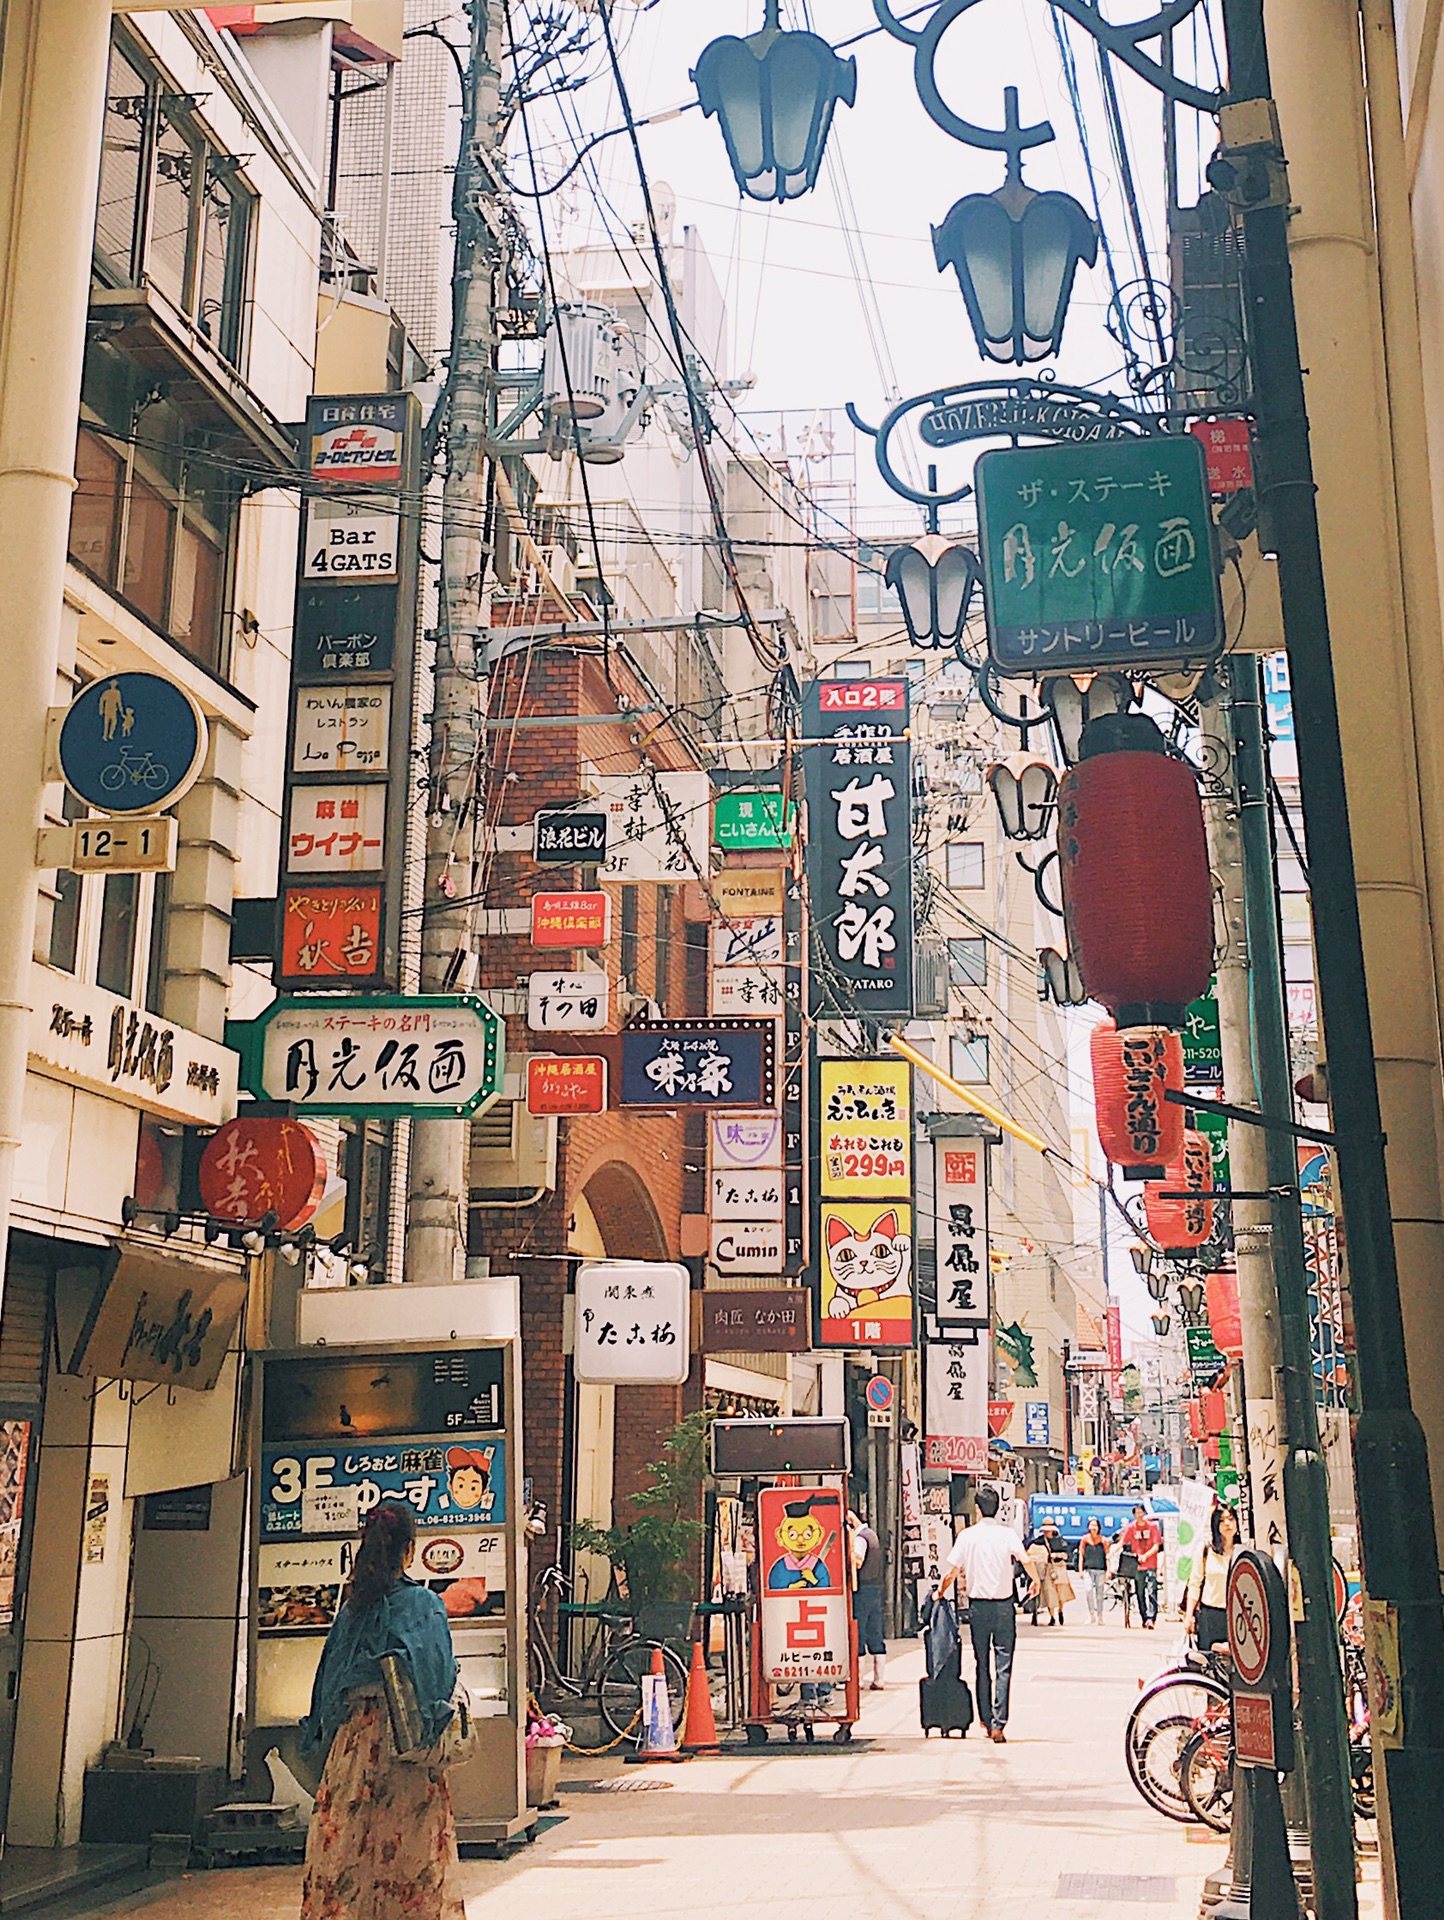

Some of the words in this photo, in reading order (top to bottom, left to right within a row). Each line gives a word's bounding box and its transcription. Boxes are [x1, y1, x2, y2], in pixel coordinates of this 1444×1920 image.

[1017, 471, 1172, 508] ザ・ステーキ
[330, 529, 377, 545] Bar
[1002, 517, 1195, 590] 月光仮面
[1017, 619, 1195, 654] サントリービール
[826, 687, 896, 707] 入口2階
[317, 718, 368, 727] レストラン
[832, 747, 893, 765] 居酒屋
[316, 801, 358, 819] 麻雀
[739, 802, 778, 818] 現代
[291, 832, 381, 856] ウイナー
[539, 826, 604, 849] 浪花ビル
[605, 856, 628, 872] 3F
[831, 773, 896, 968] 甘太郎
[722, 887, 775, 897] FONTAINE
[298, 921, 373, 972] 秋吉
[322, 1014, 430, 1032] ステーキの名門
[286, 1038, 466, 1100] 月光仮面
[534, 1062, 597, 1076] 沖縄居酒屋
[827, 1095, 895, 1121] えこひいき
[845, 1154, 905, 1176] 299円
[717, 1237, 777, 1262] Cumin
[715, 1309, 744, 1325] 肉匠
[755, 1309, 796, 1325] なか田
[598, 1322, 676, 1345] たこ梅
[851, 1321, 881, 1340] 1階
[447, 1413, 463, 1426] 5F
[401, 1449, 443, 1472] 麻雀
[478, 1538, 498, 1552] 2F
[275, 1559, 333, 1568] ステーキハウス
[786, 1600, 827, 1648] 占
[780, 1650, 833, 1662] ルビーの館
